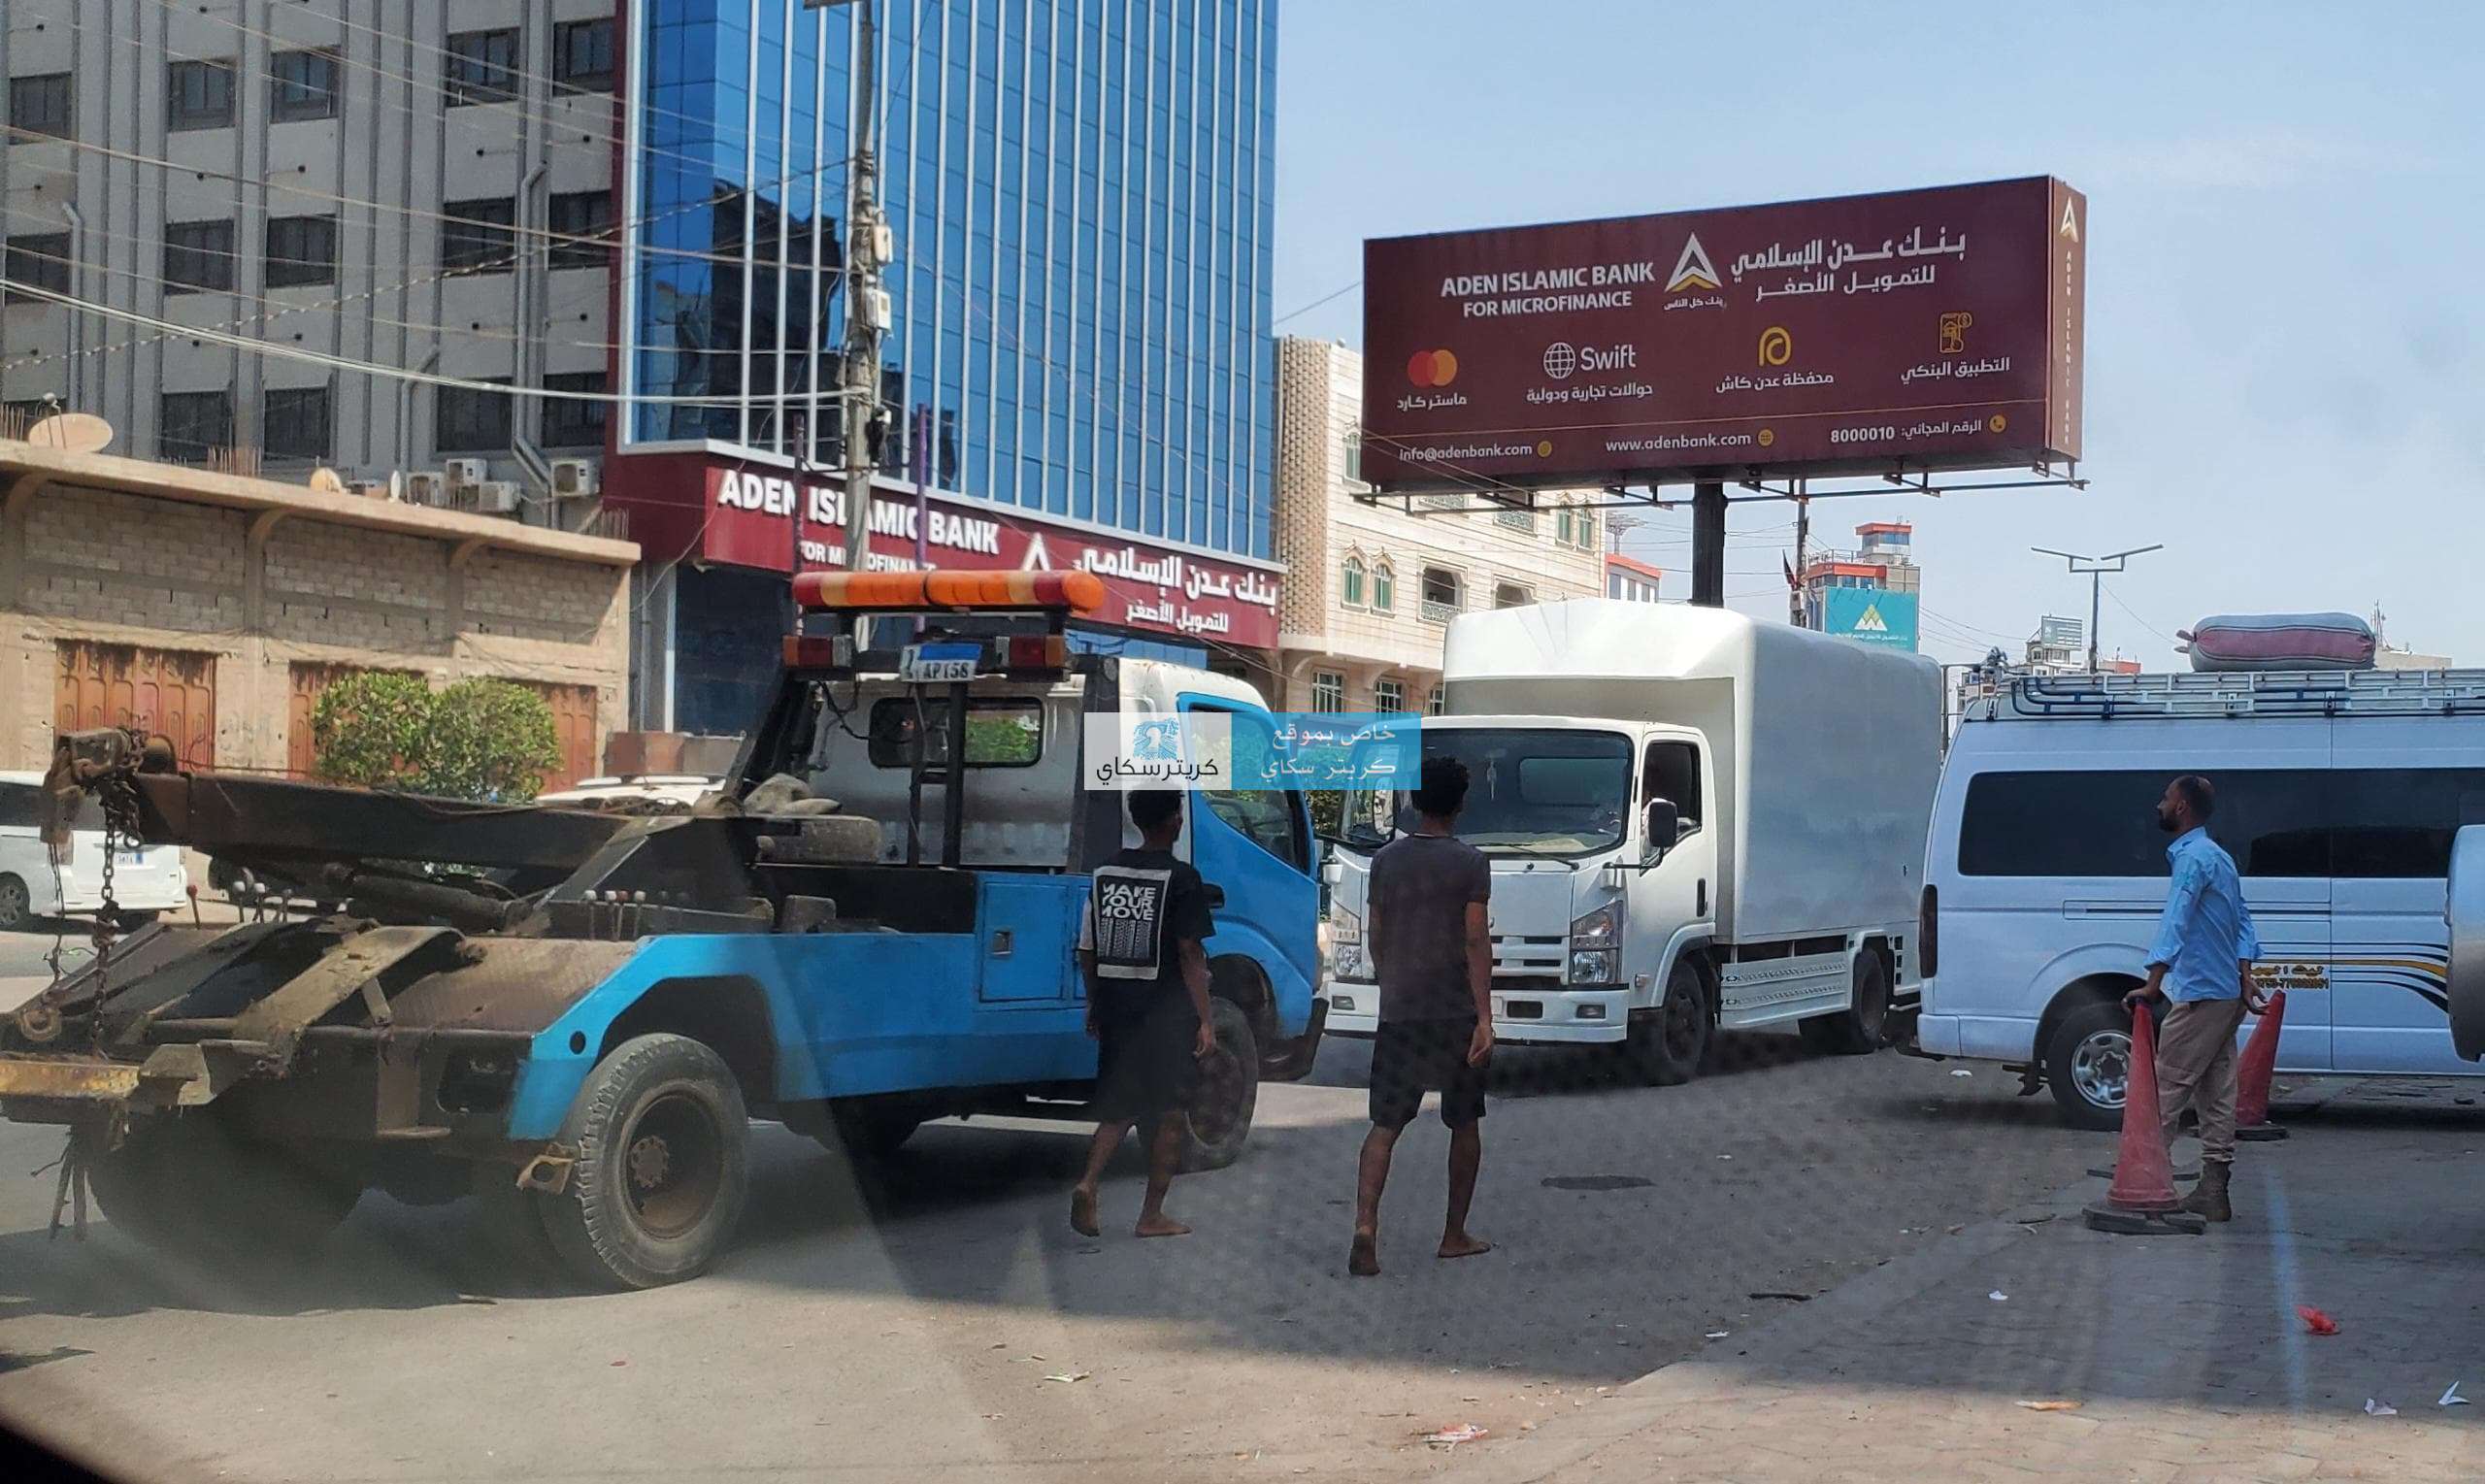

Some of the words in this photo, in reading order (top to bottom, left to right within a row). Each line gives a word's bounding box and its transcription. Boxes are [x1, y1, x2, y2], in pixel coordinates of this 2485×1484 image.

[1827, 238, 1894, 270] عدن
[1897, 225, 1967, 262] بنك
[1730, 238, 1823, 283] الإسلامي
[1441, 275, 1498, 297] ADEN
[1502, 267, 1588, 292] ISLAMIC
[1591, 262, 1656, 285] BANK
[1755, 273, 1835, 303] الأصغر
[1842, 264, 1936, 294] للتمويل
[1463, 300, 1499, 317] FOR
[1501, 291, 1633, 315] MICROFINANCE
[1579, 345, 1637, 372] Swift
[1954, 356, 2010, 379] التطبيق
[1715, 374, 1752, 394] كاش
[1753, 375, 1781, 392] عدن
[1782, 371, 1835, 387] محفظة
[1900, 360, 1951, 385] البنكي
[1428, 392, 1468, 412] ماستر
[1526, 387, 1569, 405] ودولية
[1571, 384, 1607, 403] تجارية
[1608, 381, 1654, 399] حوالات
[1396, 395, 1427, 412] كارد
[1830, 425, 1895, 444] 8000010
[1951, 419, 1982, 436] الرقم
[1398, 444, 1533, 462] info@adenbank.com
[1606, 433, 1751, 453] www.adenbank.com
[717, 469, 797, 516] ADEN
[808, 486, 919, 542] ISLMIC
[927, 510, 1001, 555] BANK
[1184, 564, 1231, 601] عدن
[1234, 572, 1276, 616] بنك
[1125, 599, 1174, 624] الأصغر
[1176, 606, 1230, 634] للتمويل
